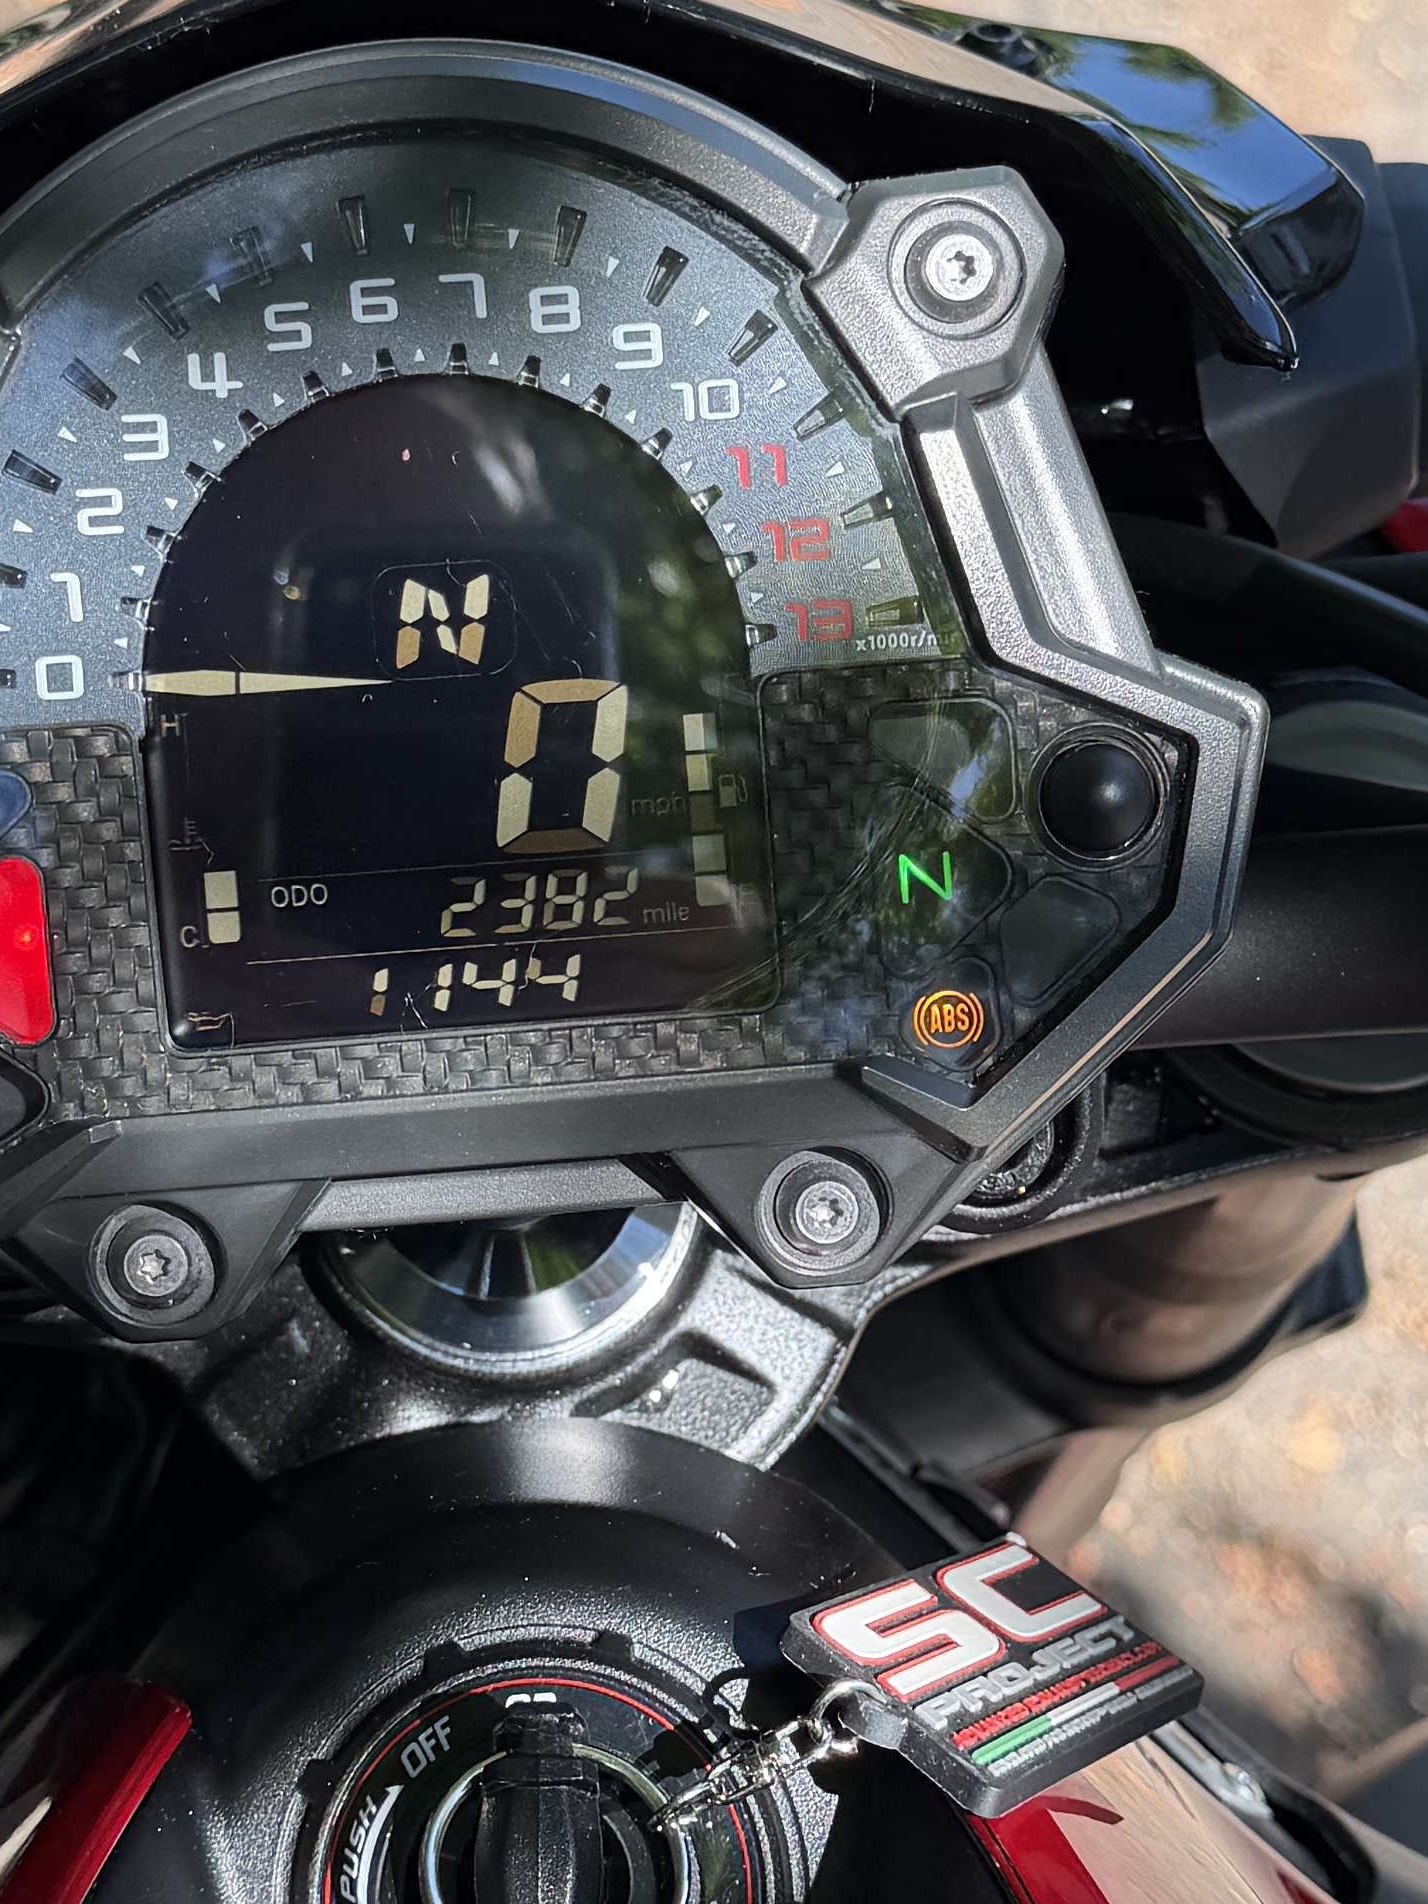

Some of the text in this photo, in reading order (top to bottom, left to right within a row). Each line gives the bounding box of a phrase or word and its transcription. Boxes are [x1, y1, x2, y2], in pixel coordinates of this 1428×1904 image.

[350, 278, 398, 324] 6
[439, 273, 488, 319] 7
[528, 285, 581, 333] 8
[263, 301, 313, 351] 5
[612, 322, 664, 369] 9
[187, 352, 243, 399] 4
[671, 378, 740, 422] 10
[121, 414, 170, 461] 3
[725, 443, 787, 489] 11
[76, 488, 124, 536] 2
[762, 518, 829, 563] 12
[50, 572, 84, 622] 1
[785, 599, 852, 642] 13
[395, 573, 490, 669] N
[35, 655, 85, 700] 0
[496, 678, 628, 854] 0
[897, 850, 954, 904] N
[271, 867, 691, 938] ODO 2382 mile
[180, 925, 200, 949] C
[929, 1003, 972, 1035] ABS
[812, 1541, 1108, 1702] SC
[914, 1615, 1134, 1731] PROJECT
[400, 1715, 453, 1779] OFF
[338, 1798, 378, 1904] PUSH
